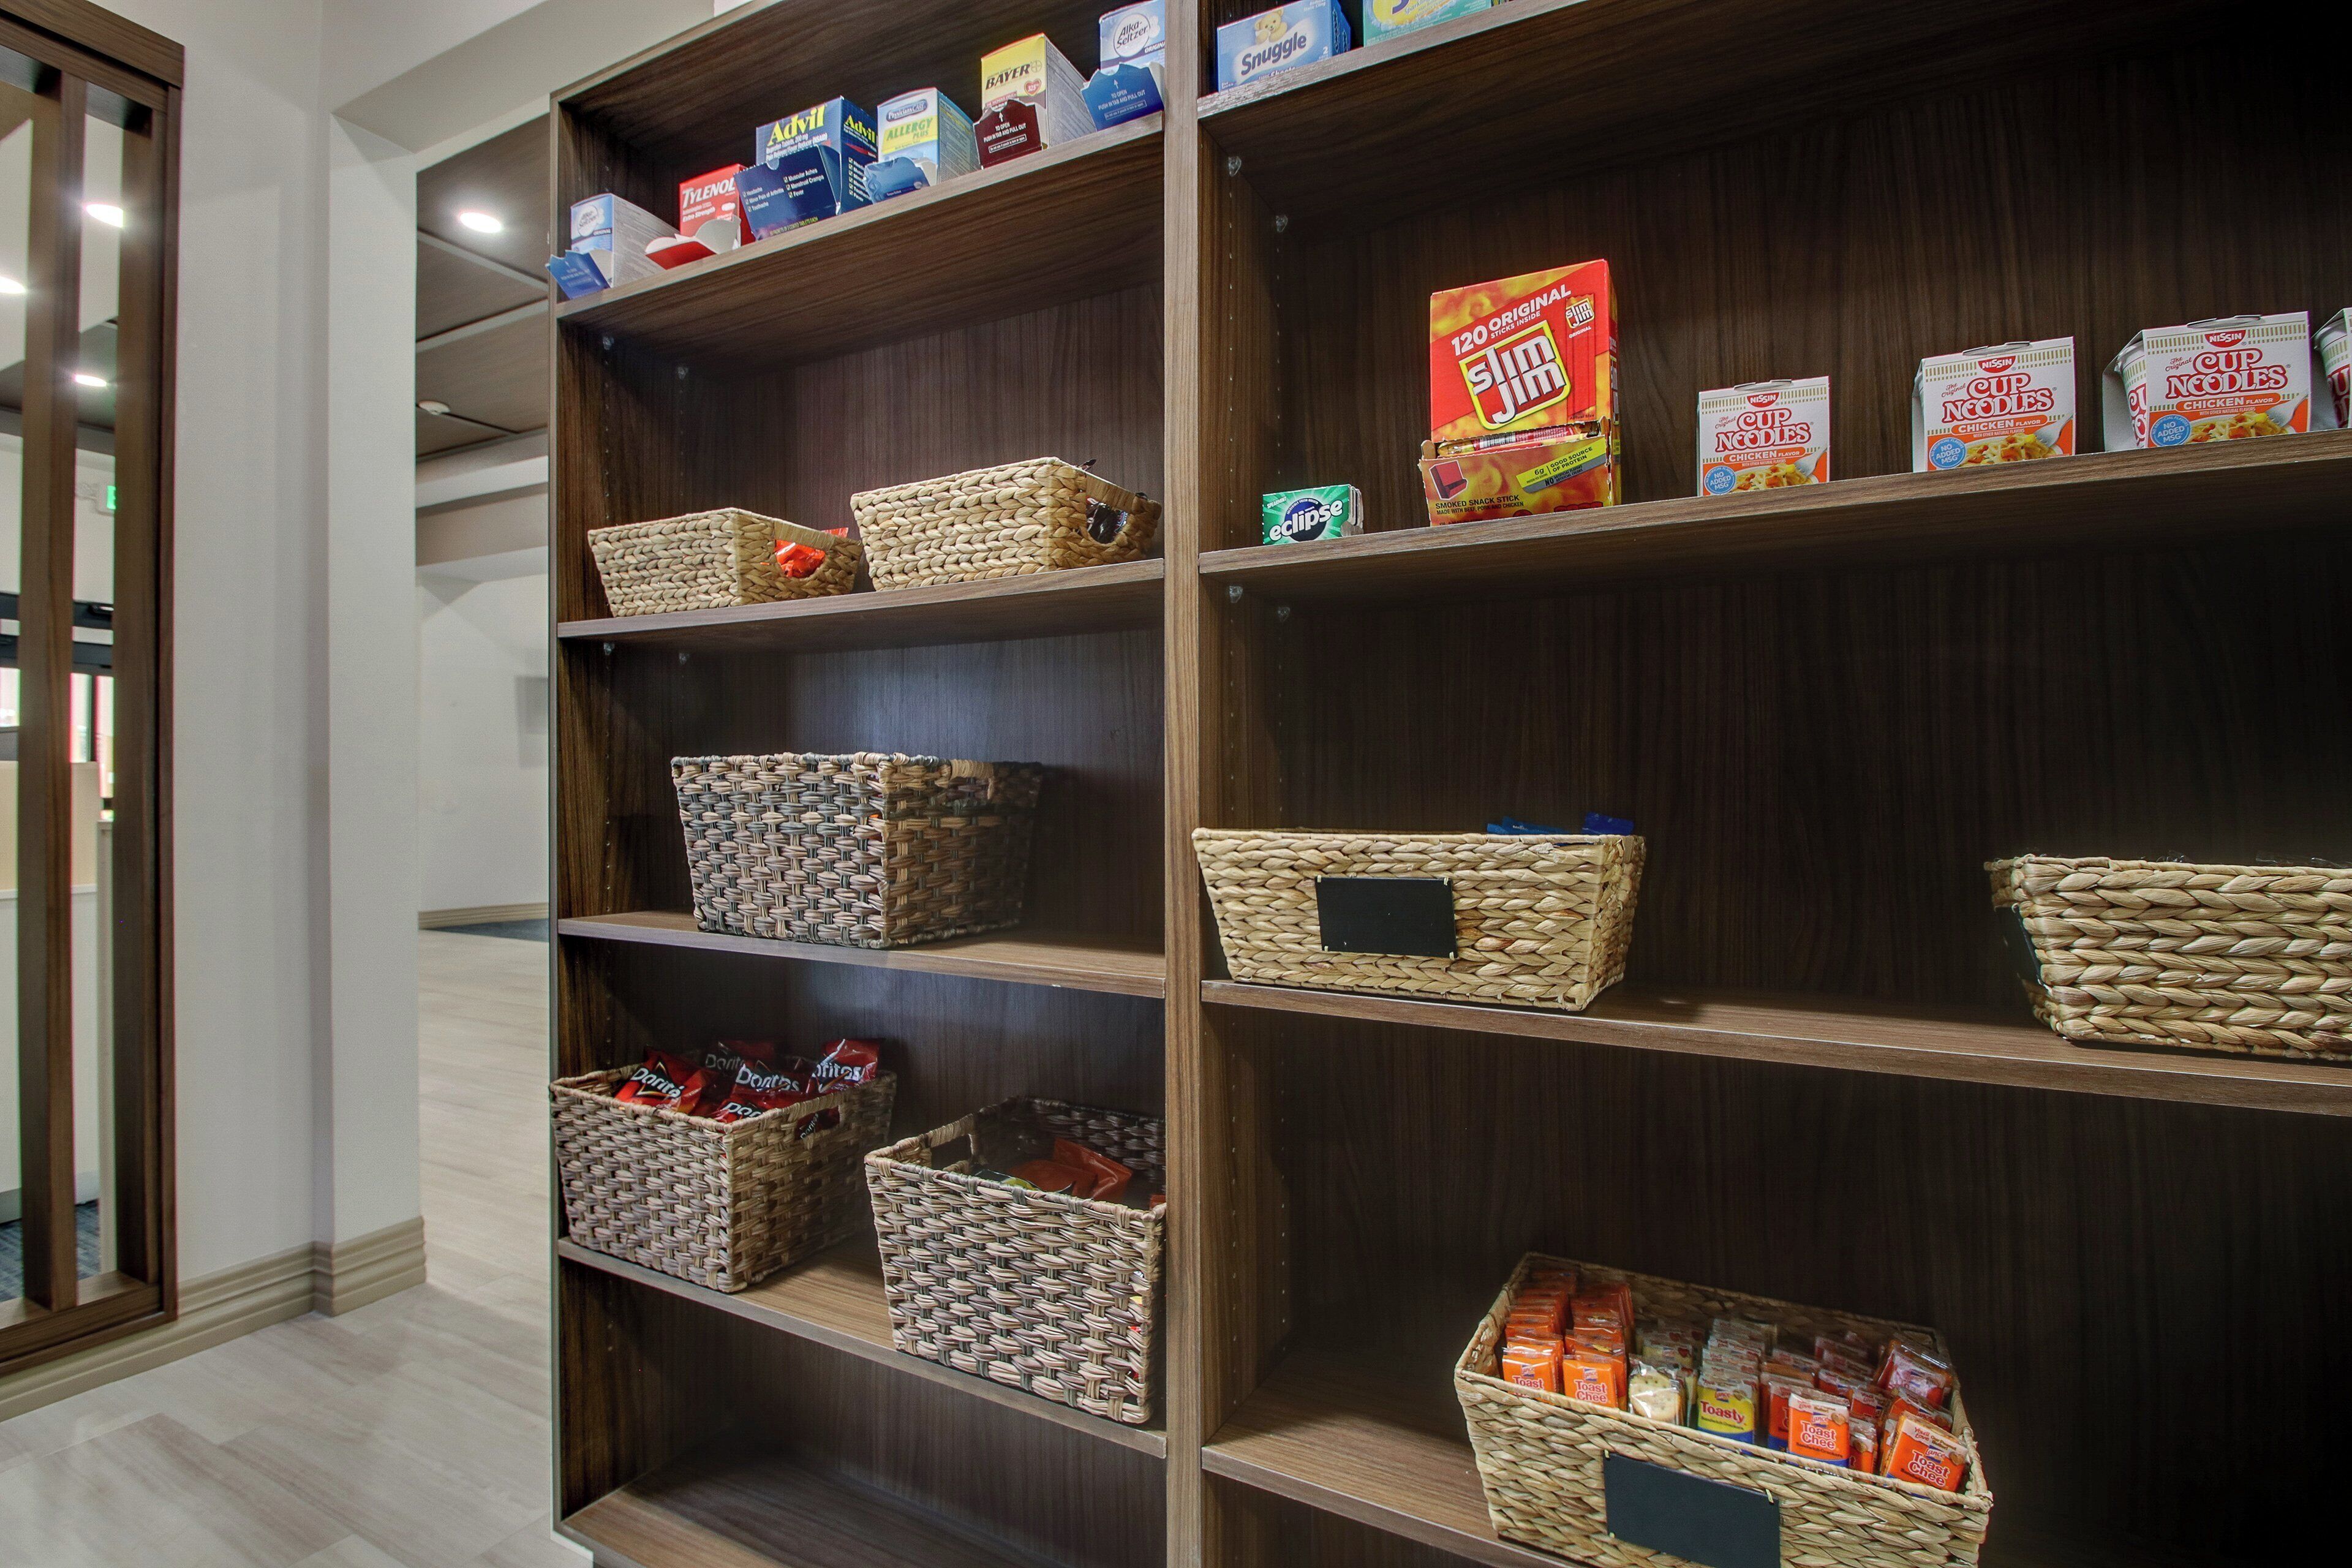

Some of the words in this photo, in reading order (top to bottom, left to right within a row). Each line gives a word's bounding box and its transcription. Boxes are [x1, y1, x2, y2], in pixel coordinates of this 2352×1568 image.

[1117, 26, 1148, 48] Seltzer
[1118, 20, 1142, 39] Alka-
[1241, 32, 1306, 75] Snuggle
[1323, 46, 1329, 55] 2
[986, 64, 1030, 90] BAYER
[767, 105, 825, 146] Advil
[845, 115, 875, 144] Advil
[886, 118, 933, 141] ALLERGY
[913, 130, 929, 140] PLUS
[788, 172, 805, 182] Muscular
[805, 168, 818, 176] Aches
[790, 179, 809, 190] Menstrual
[809, 175, 824, 184] Cramps
[682, 178, 735, 209] TYLENOL
[1451, 325, 1488, 356] 120
[1488, 284, 1572, 332] ORIGINAL
[1491, 322, 1515, 339] STICKS
[1517, 311, 1541, 327] INSIDE
[1569, 326, 1593, 338] ORIGINAL
[2209, 333, 2242, 343] NISSIN
[1981, 359, 2013, 369] NISSIN
[2165, 356, 2193, 372] Original
[2169, 356, 2183, 365] The
[2194, 348, 2263, 374] CUP
[1968, 373, 2030, 399] CUP
[2166, 364, 2288, 399] NOODLES
[1942, 382, 1966, 398] Original
[1750, 394, 1776, 404] NISSIN
[1942, 388, 2054, 423] NOODLES
[2183, 397, 2244, 410] CHICKEN
[1715, 417, 1736, 429] Original
[1738, 408, 1792, 430] CUP
[1958, 419, 2014, 433] CHICKEN
[1716, 423, 1811, 452] NOODLES
[2157, 426, 2185, 437] ADDED
[2163, 434, 2181, 442] MSG
[1550, 457, 1567, 468] GOOD
[1568, 446, 1593, 461] SOURCE
[1728, 451, 1777, 462] CHICKEN
[1936, 448, 1960, 459] ADDED
[1942, 456, 1958, 464] MSG
[1562, 454, 1588, 469] PROTEIN
[1534, 467, 1545, 477] 6g
[1710, 476, 1731, 486] ADDED
[1267, 496, 1286, 509] SPEARMINT
[1436, 501, 1466, 510] SMOKED
[1469, 497, 1494, 507] SNACK
[1269, 500, 1343, 541] eclipse
[735, 1066, 800, 1092] Doritos
[1513, 1376, 1544, 1389] Toast
[1575, 1380, 1607, 1393] Toast
[1576, 1391, 1607, 1403] Chee
[1700, 1400, 1745, 1423] Toasty
[1801, 1420, 1836, 1440] Toast
[1801, 1432, 1836, 1450] Chee
[1926, 1448, 1946, 1458] Lance
[1912, 1449, 1950, 1479] Toast
[1908, 1460, 1945, 1487] Chee
